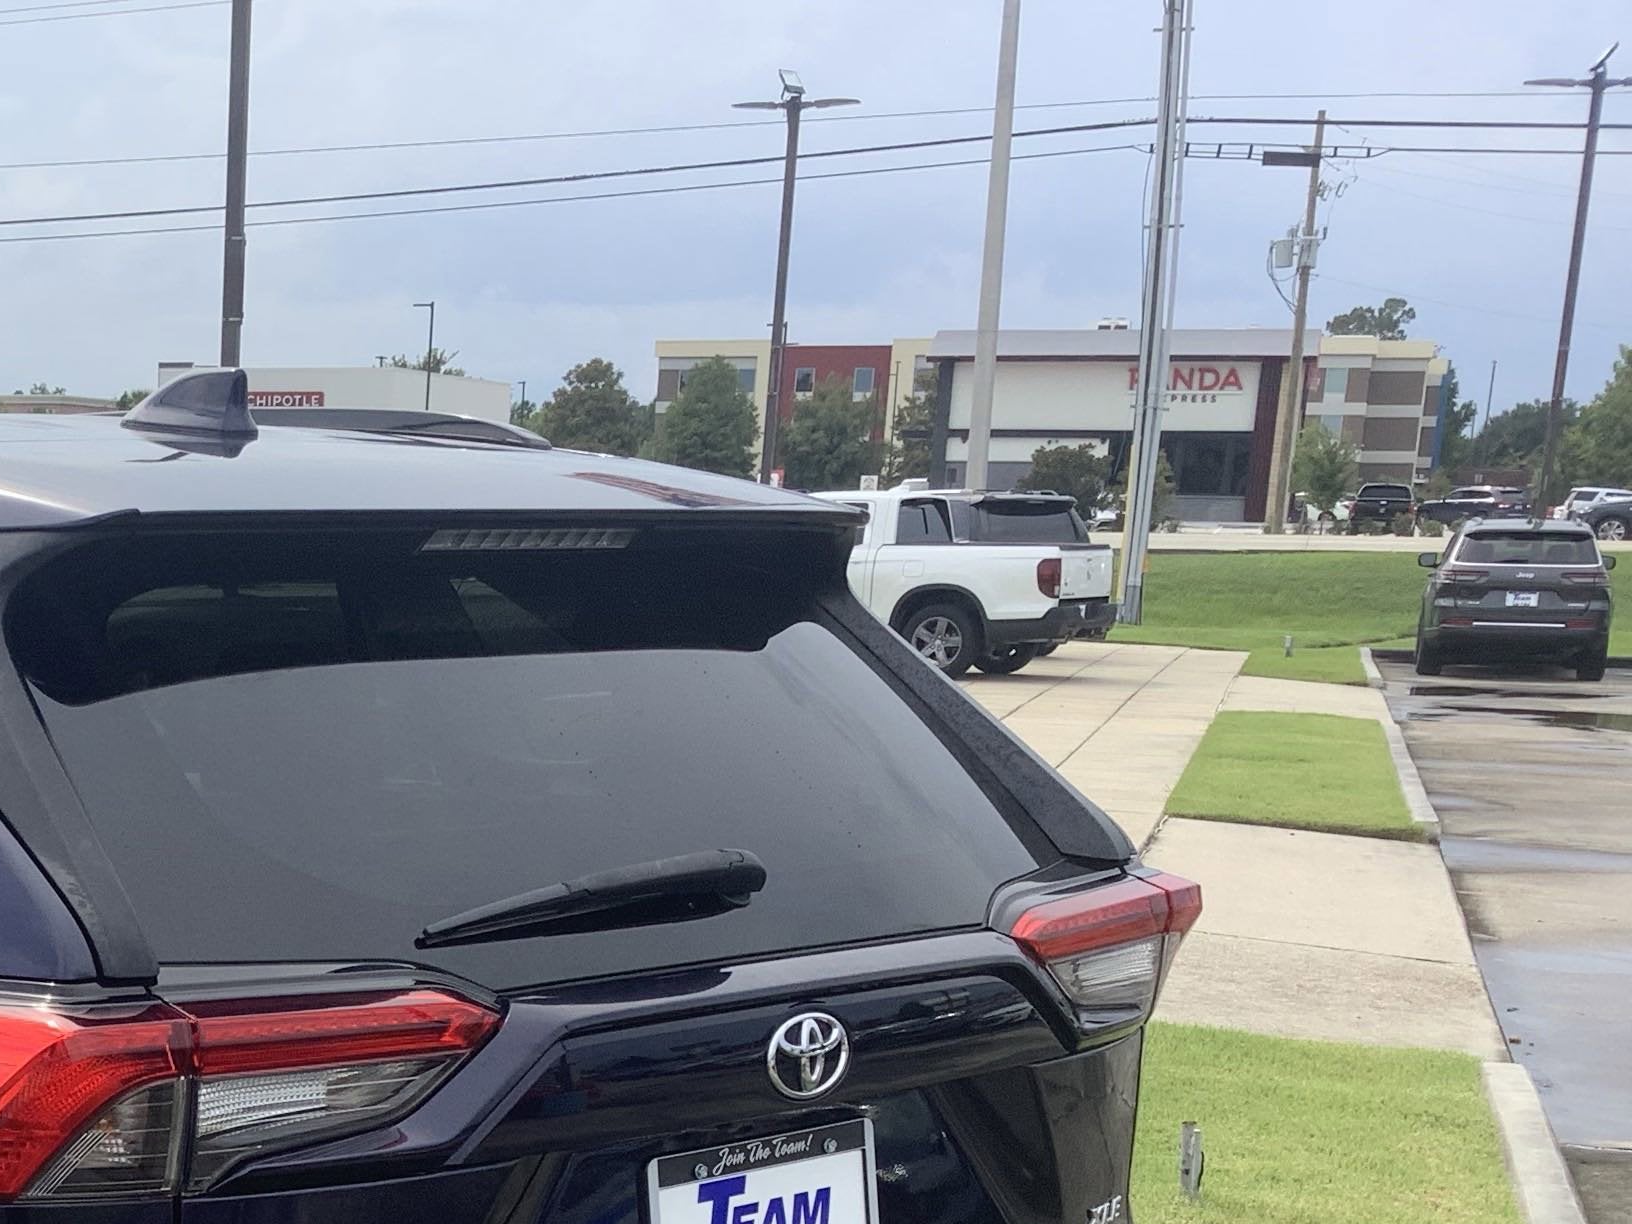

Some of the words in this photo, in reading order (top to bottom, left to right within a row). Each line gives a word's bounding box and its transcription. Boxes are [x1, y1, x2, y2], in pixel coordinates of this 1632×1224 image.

[1128, 367, 1243, 391] PNDA
[712, 1147, 745, 1176] Join
[745, 1141, 772, 1164] The
[772, 1134, 814, 1159] Team!
